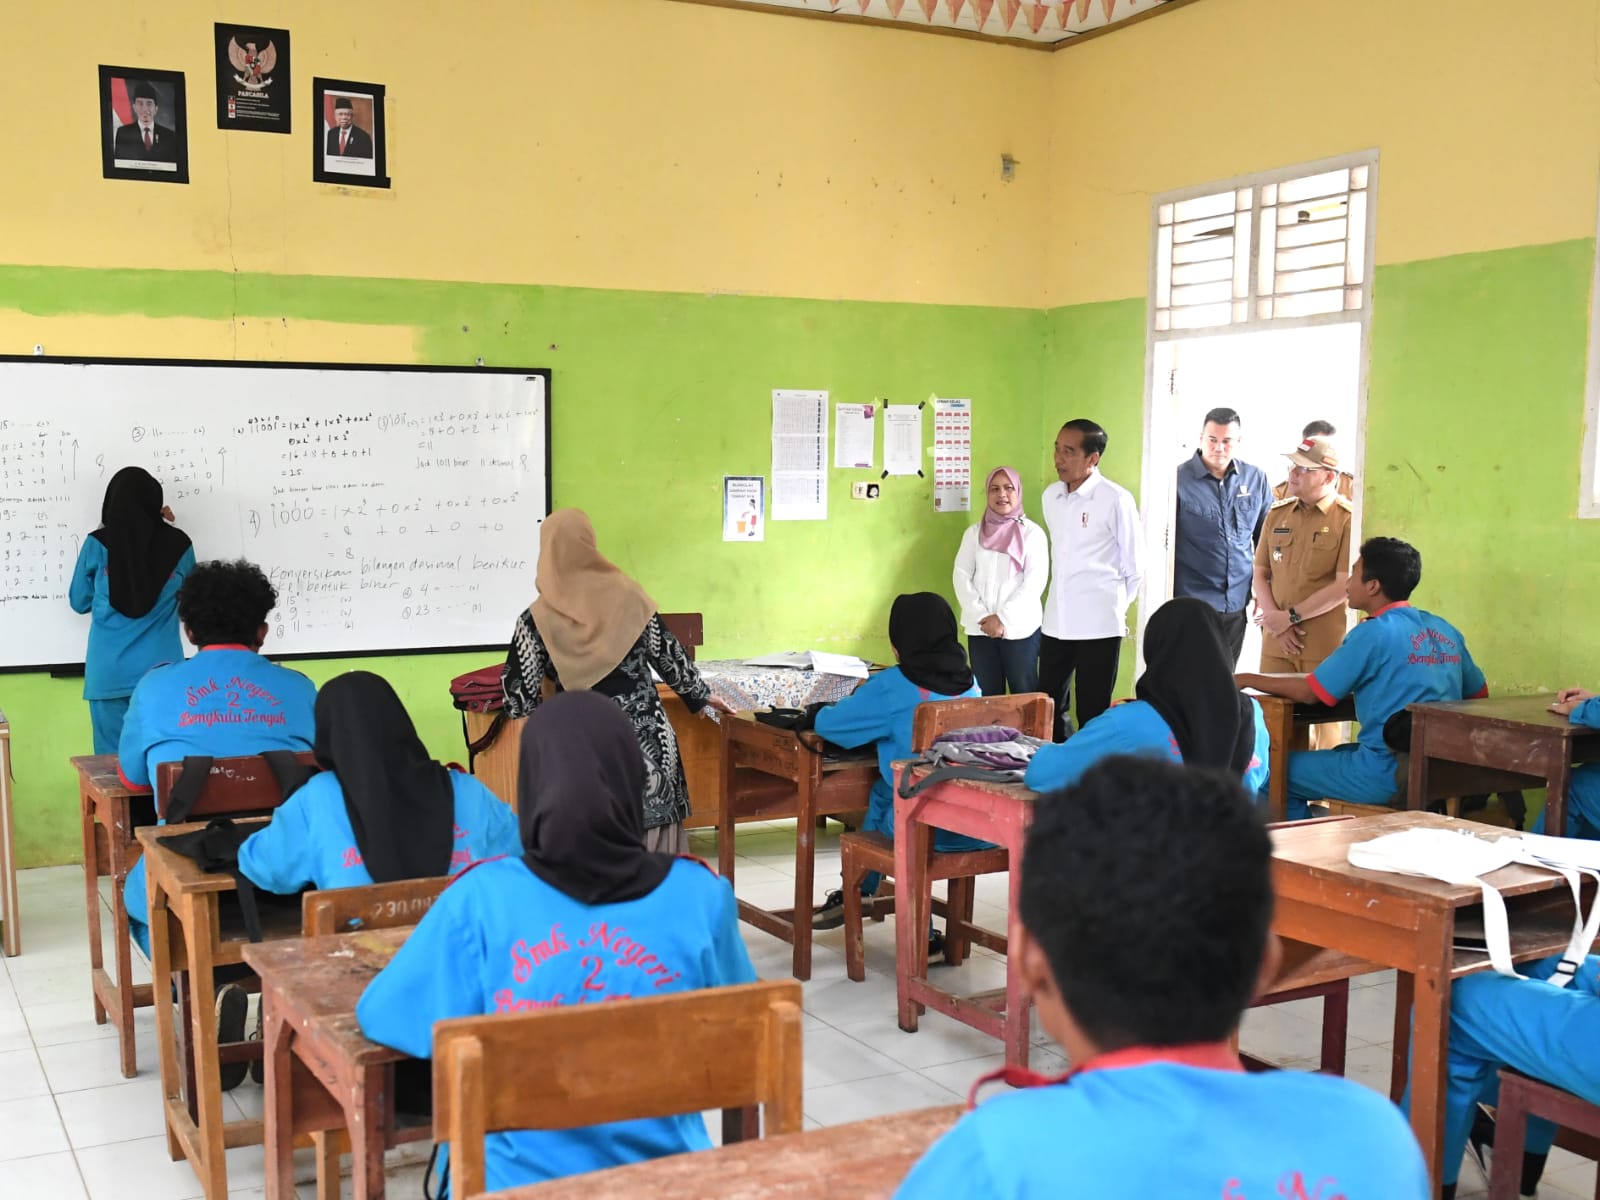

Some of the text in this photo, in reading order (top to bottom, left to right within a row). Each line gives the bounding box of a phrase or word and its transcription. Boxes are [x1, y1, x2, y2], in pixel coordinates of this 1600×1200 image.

[186, 676, 284, 708] Smk Negeri
[226, 691, 242, 708] 2
[178, 708, 287, 728] Bengkulu Tengah
[510, 922, 681, 989] Smk Negeri
[580, 956, 605, 990] 2
